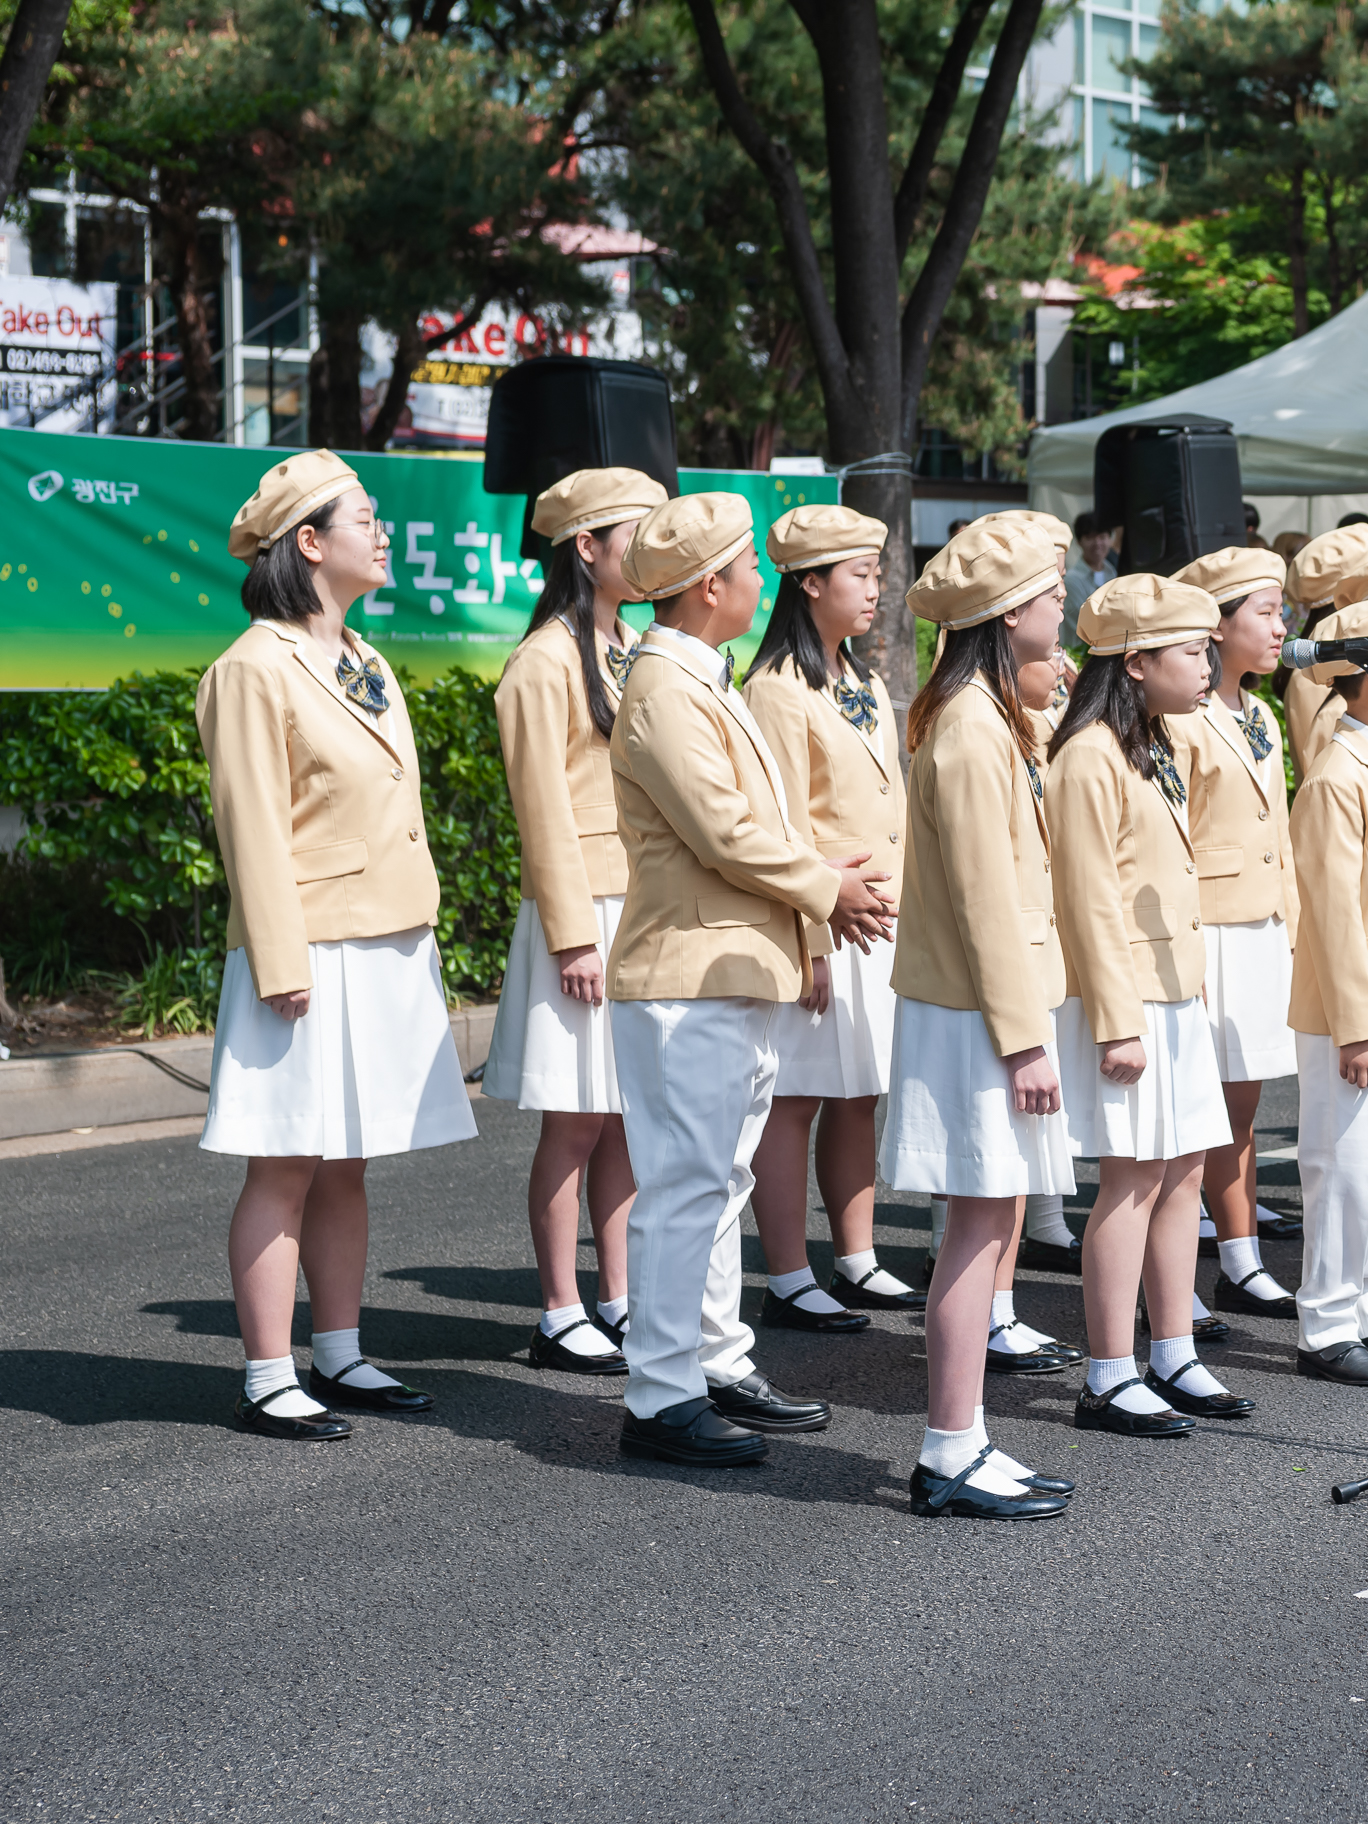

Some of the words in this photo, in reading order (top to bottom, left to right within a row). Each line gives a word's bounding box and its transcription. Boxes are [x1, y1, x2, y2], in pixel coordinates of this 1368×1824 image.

[0, 302, 49, 334] ake
[57, 305, 103, 338] Out
[420, 311, 506, 356] ake
[71, 478, 139, 505] 광진구
